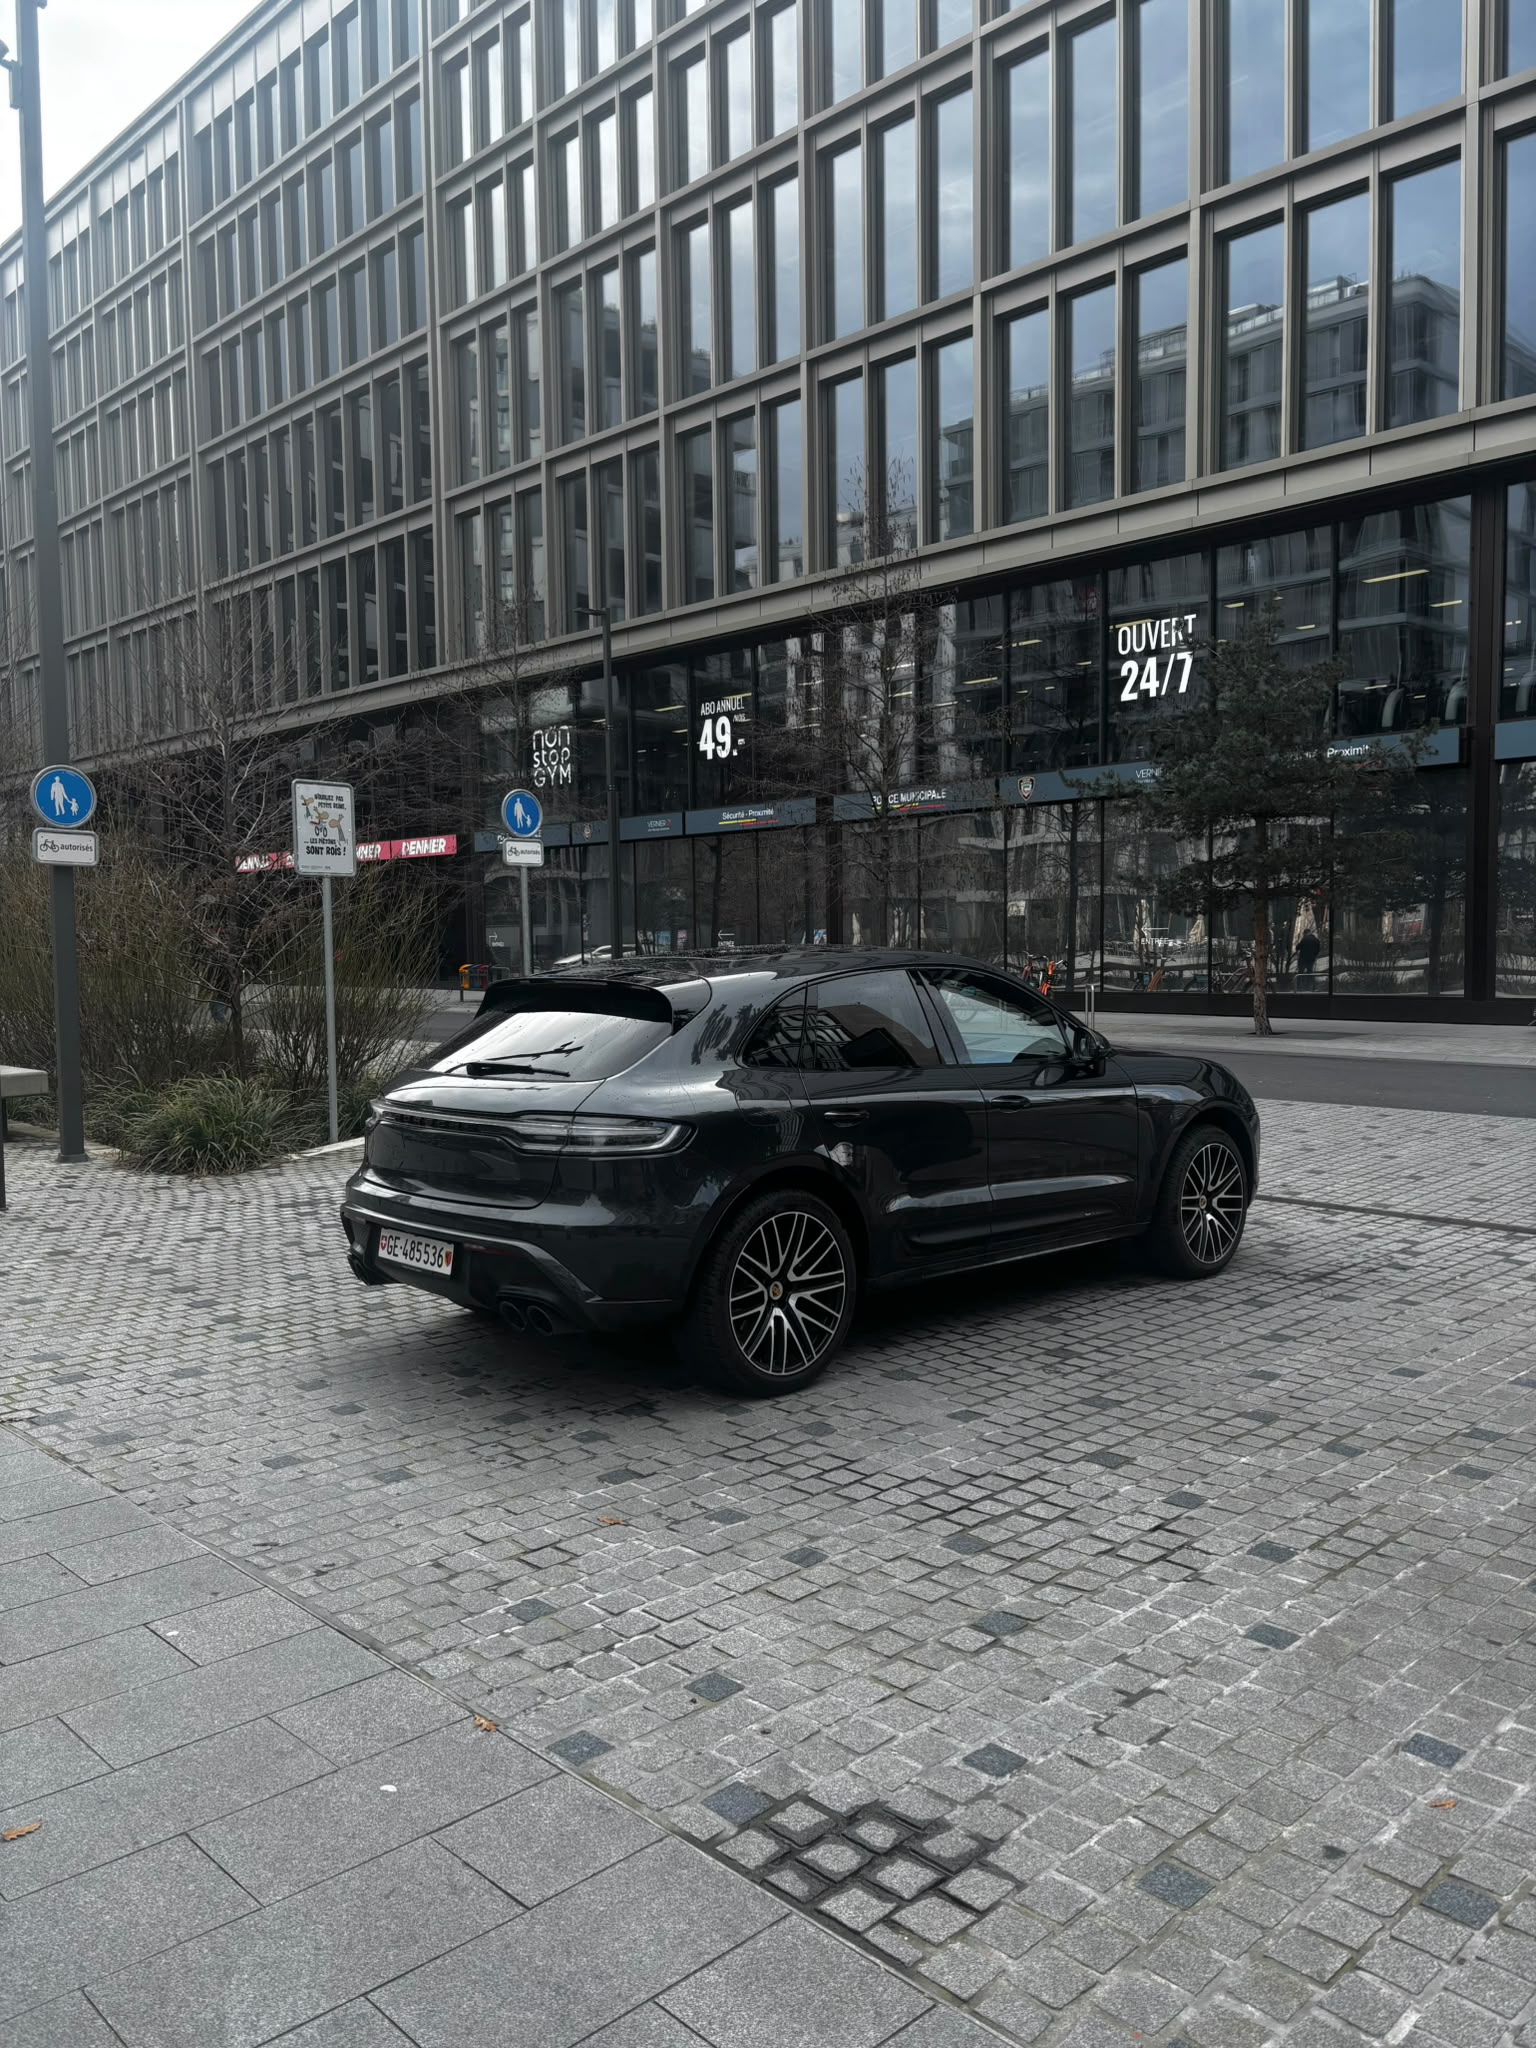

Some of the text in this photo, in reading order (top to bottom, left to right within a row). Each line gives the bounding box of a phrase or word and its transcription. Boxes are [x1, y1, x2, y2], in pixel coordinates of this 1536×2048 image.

[1118, 614, 1197, 655] OUVERT
[1120, 651, 1194, 702] 24/7
[700, 695, 745, 716] ABO ANNUEL
[533, 747, 571, 768] stop
[1326, 743, 1371, 759] Proximit
[534, 763, 571, 788] GYM
[871, 792, 899, 805] POCE
[722, 810, 745, 820] Sécurité
[748, 806, 774, 817] Proximité
[60, 843, 94, 852] autorisés
[306, 845, 324, 855] SONT
[401, 838, 447, 857] DENNER
